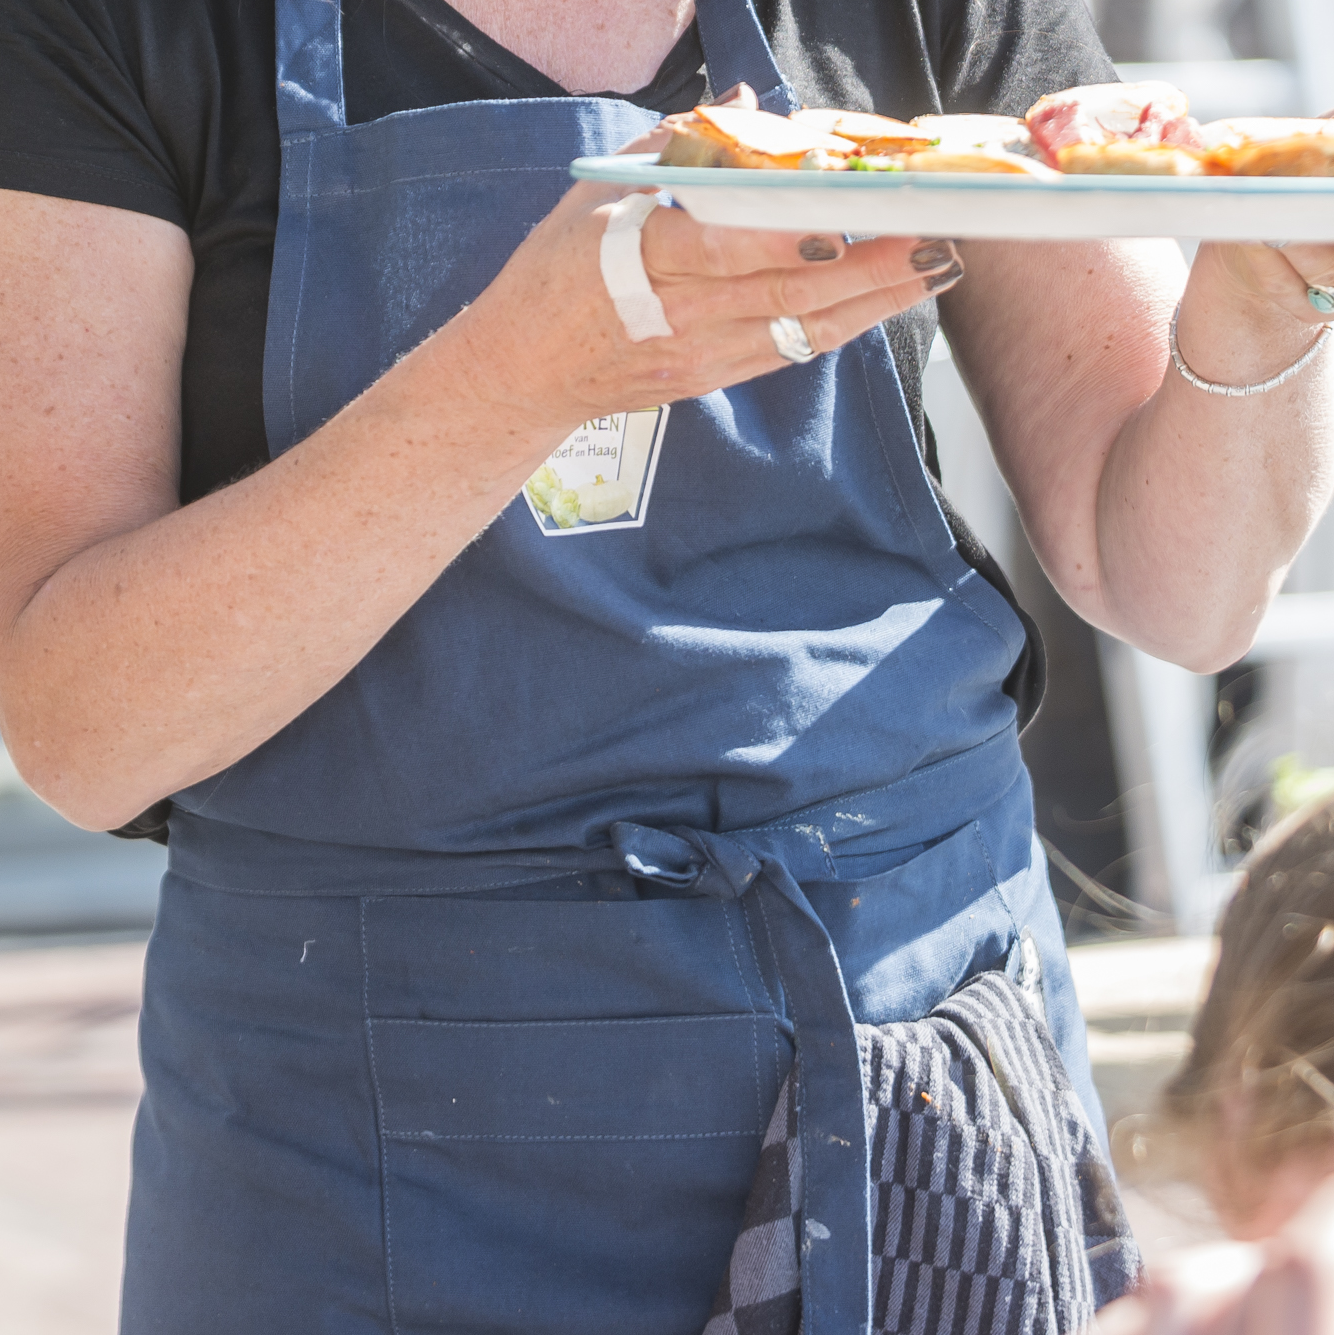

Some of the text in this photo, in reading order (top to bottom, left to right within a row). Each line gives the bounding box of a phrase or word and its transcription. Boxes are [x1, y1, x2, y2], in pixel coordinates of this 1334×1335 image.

[551, 443, 617, 459] oef en Haag
